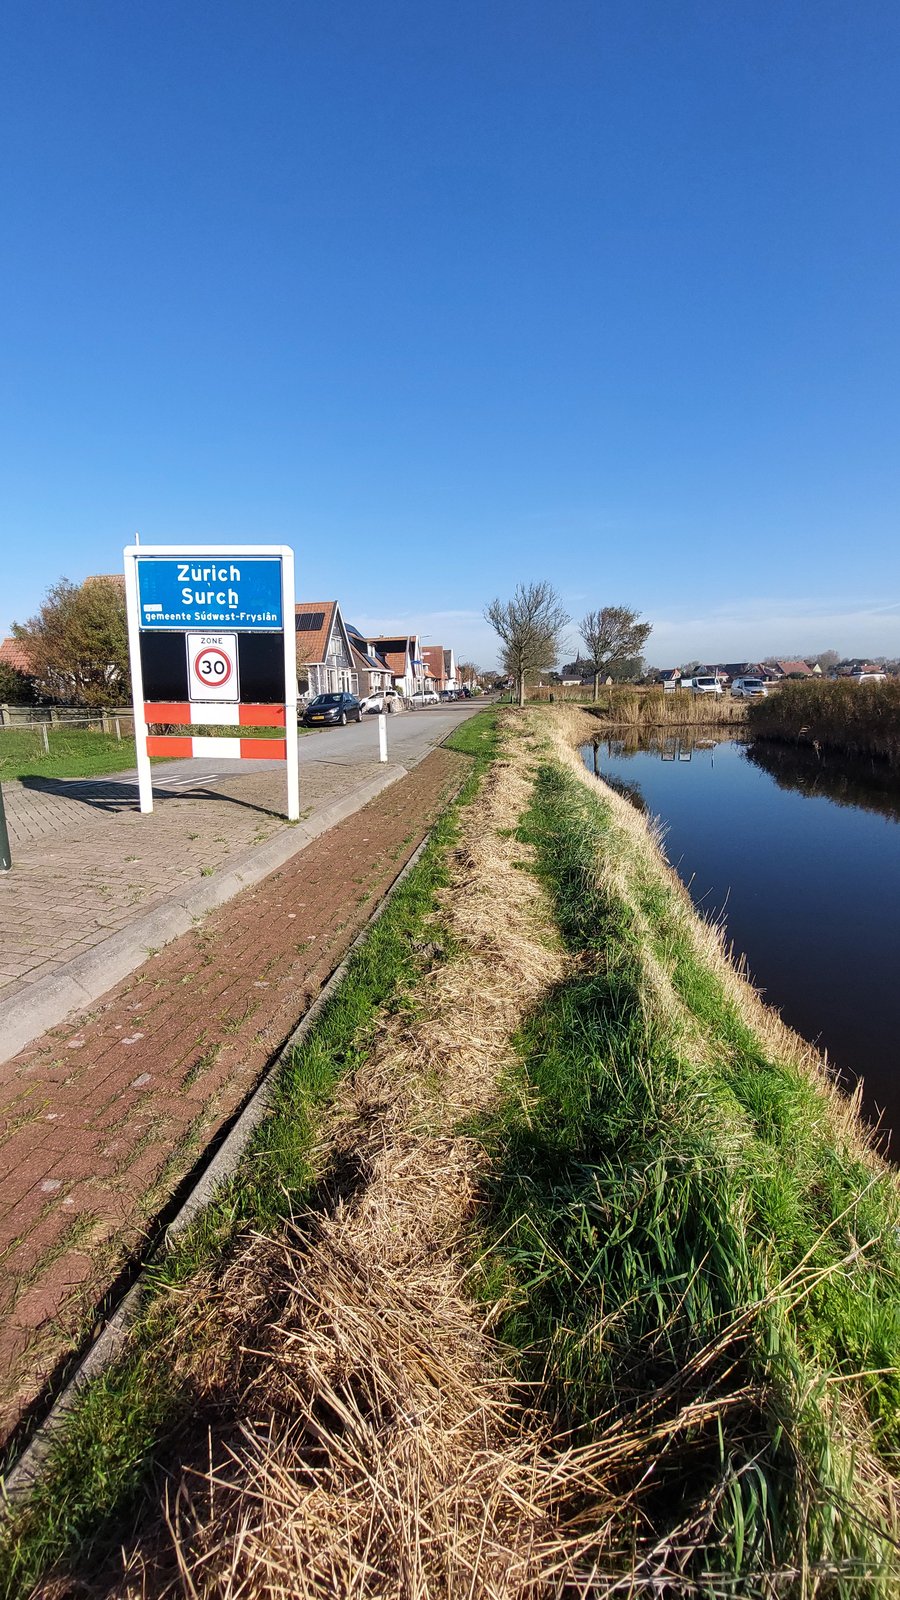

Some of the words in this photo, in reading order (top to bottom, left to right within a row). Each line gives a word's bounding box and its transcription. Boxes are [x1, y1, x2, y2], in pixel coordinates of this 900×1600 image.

[181, 587, 239, 606] Surch
[145, 612, 192, 622] gemeente
[194, 611, 278, 623] Súdwest-Fryslân
[200, 637, 223, 645] ZONE
[201, 660, 225, 675] 30
